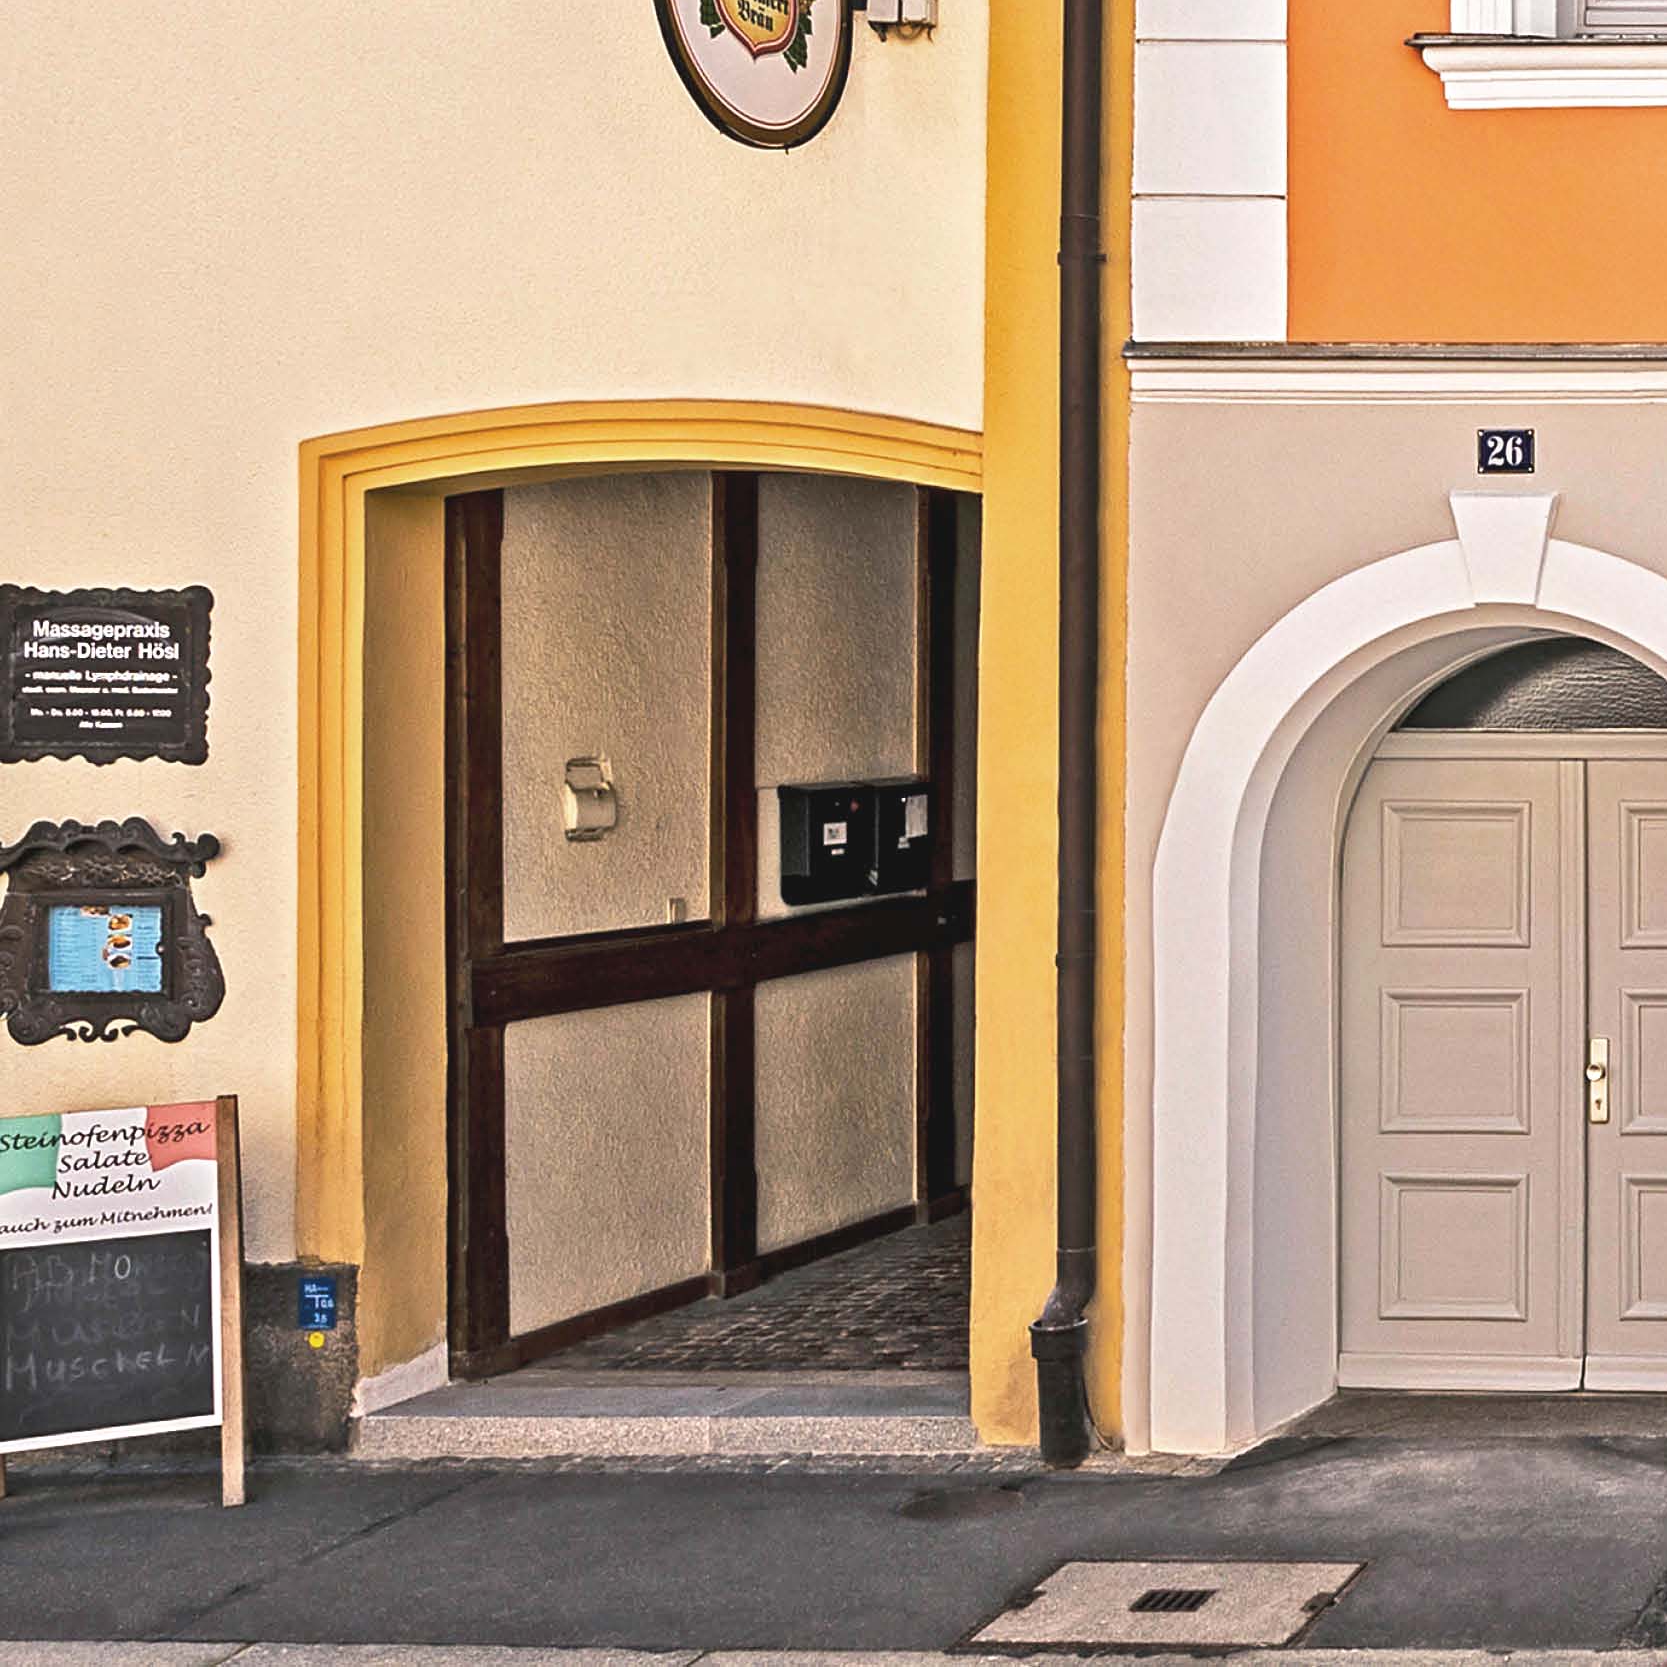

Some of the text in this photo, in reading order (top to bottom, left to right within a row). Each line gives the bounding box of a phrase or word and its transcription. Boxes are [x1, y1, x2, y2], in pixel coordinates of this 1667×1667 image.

[1487, 436, 1523, 466] 26
[33, 620, 170, 640] Massagepraxis
[24, 641, 179, 659] Hans-Dieter Hösl
[0, 1121, 210, 1152] Steinofenpizza
[58, 1150, 151, 1173] Salate
[52, 1174, 161, 1200] Nudeln
[0, 1203, 213, 1235] auch zum Mitnehmen!
